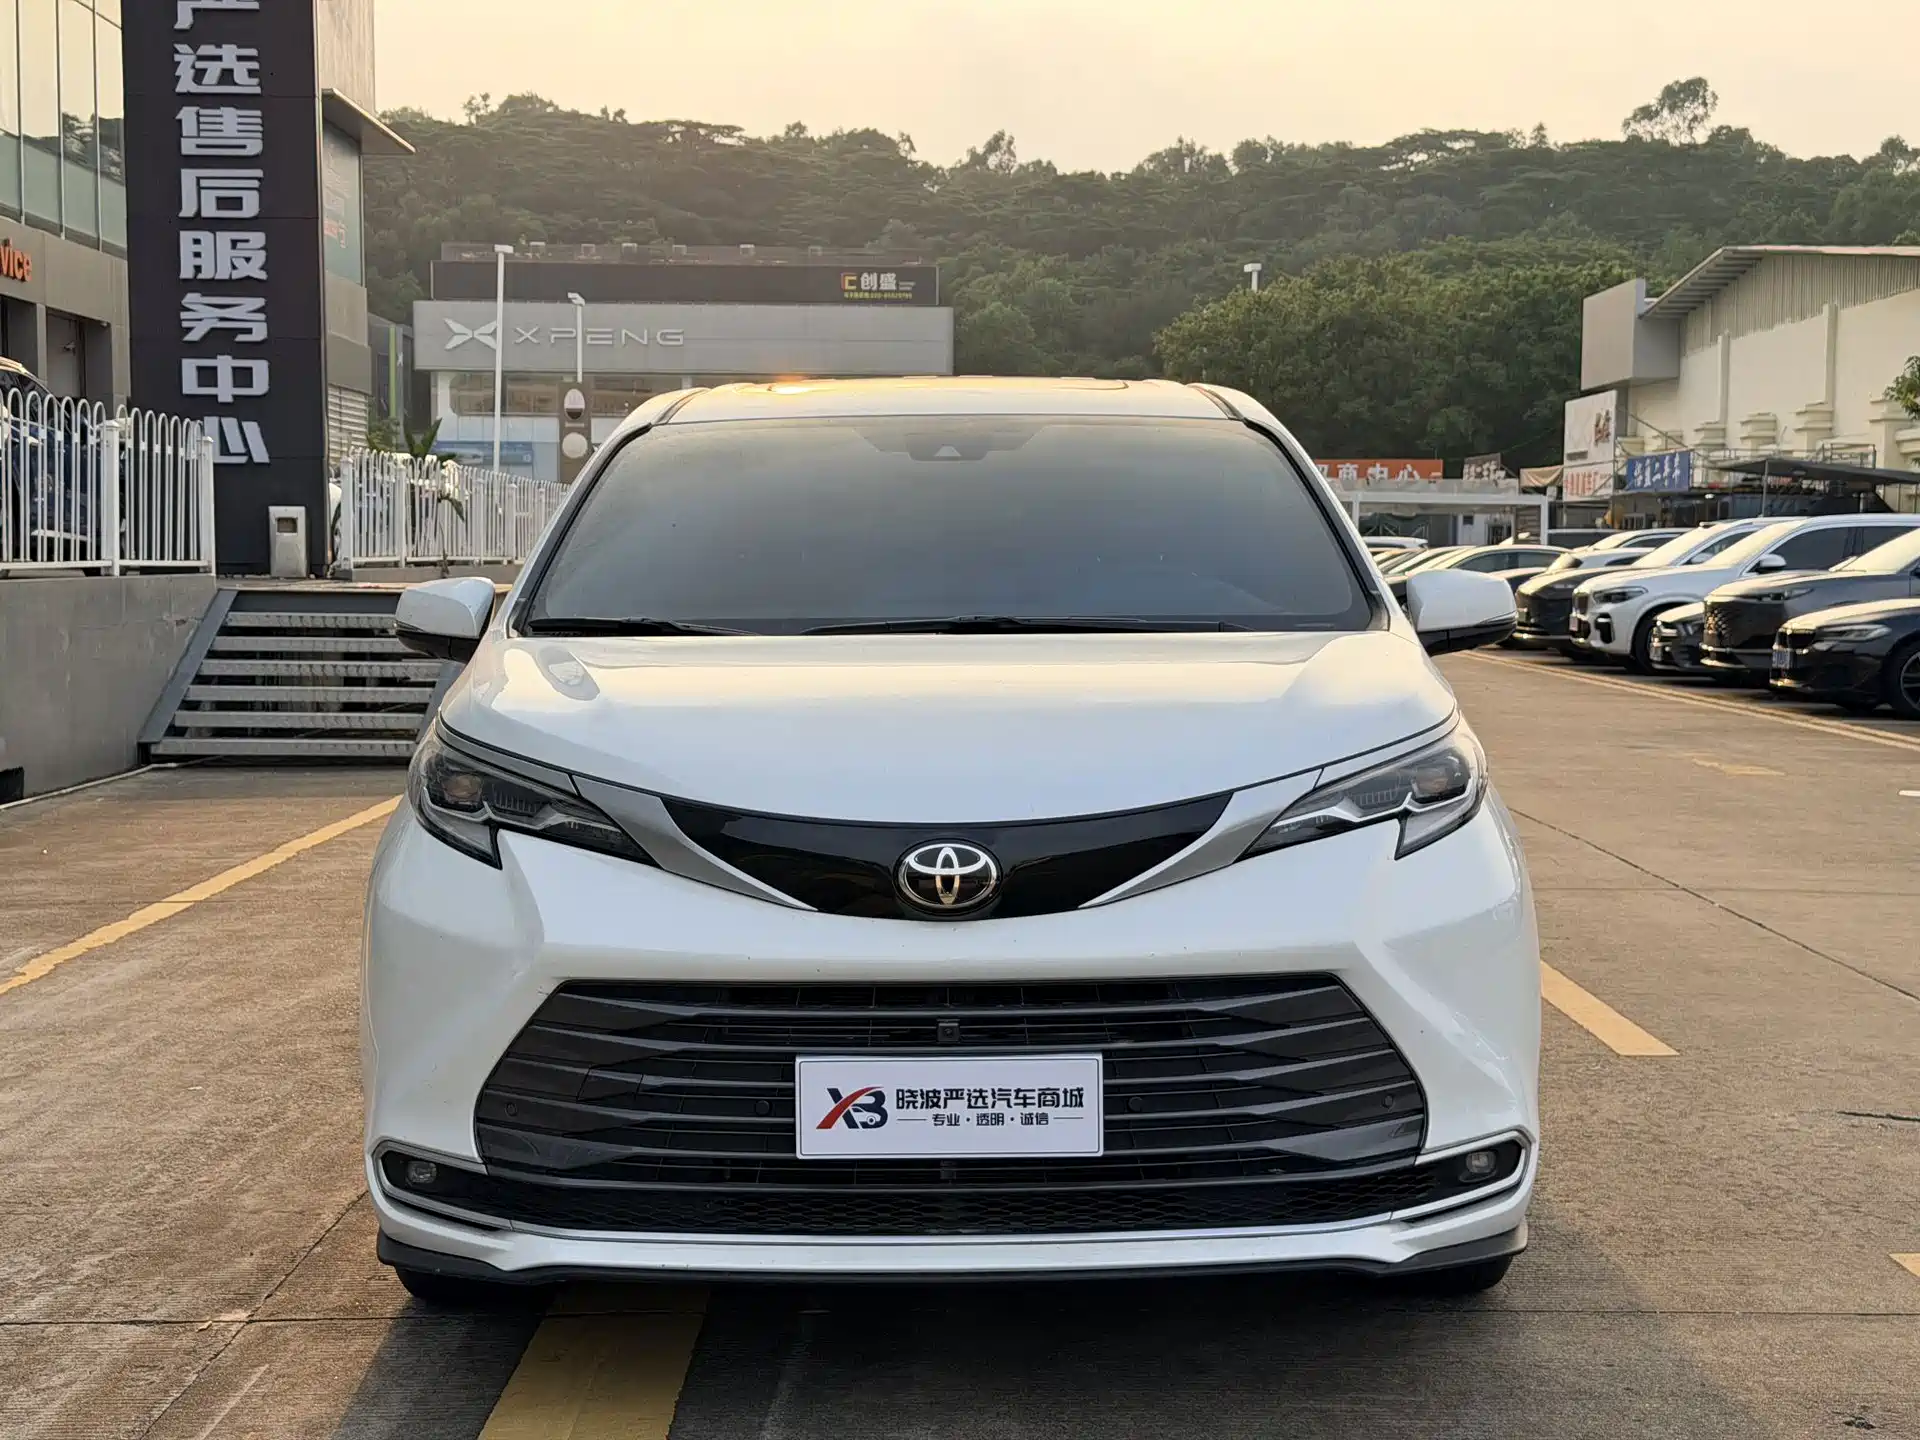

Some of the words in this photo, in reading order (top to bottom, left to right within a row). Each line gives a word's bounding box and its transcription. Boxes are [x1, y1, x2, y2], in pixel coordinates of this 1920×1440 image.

[860, 272, 897, 291] 创盛
[513, 327, 684, 346] XPENG
[895, 1087, 1084, 1110] 晓波严选汽车商城
